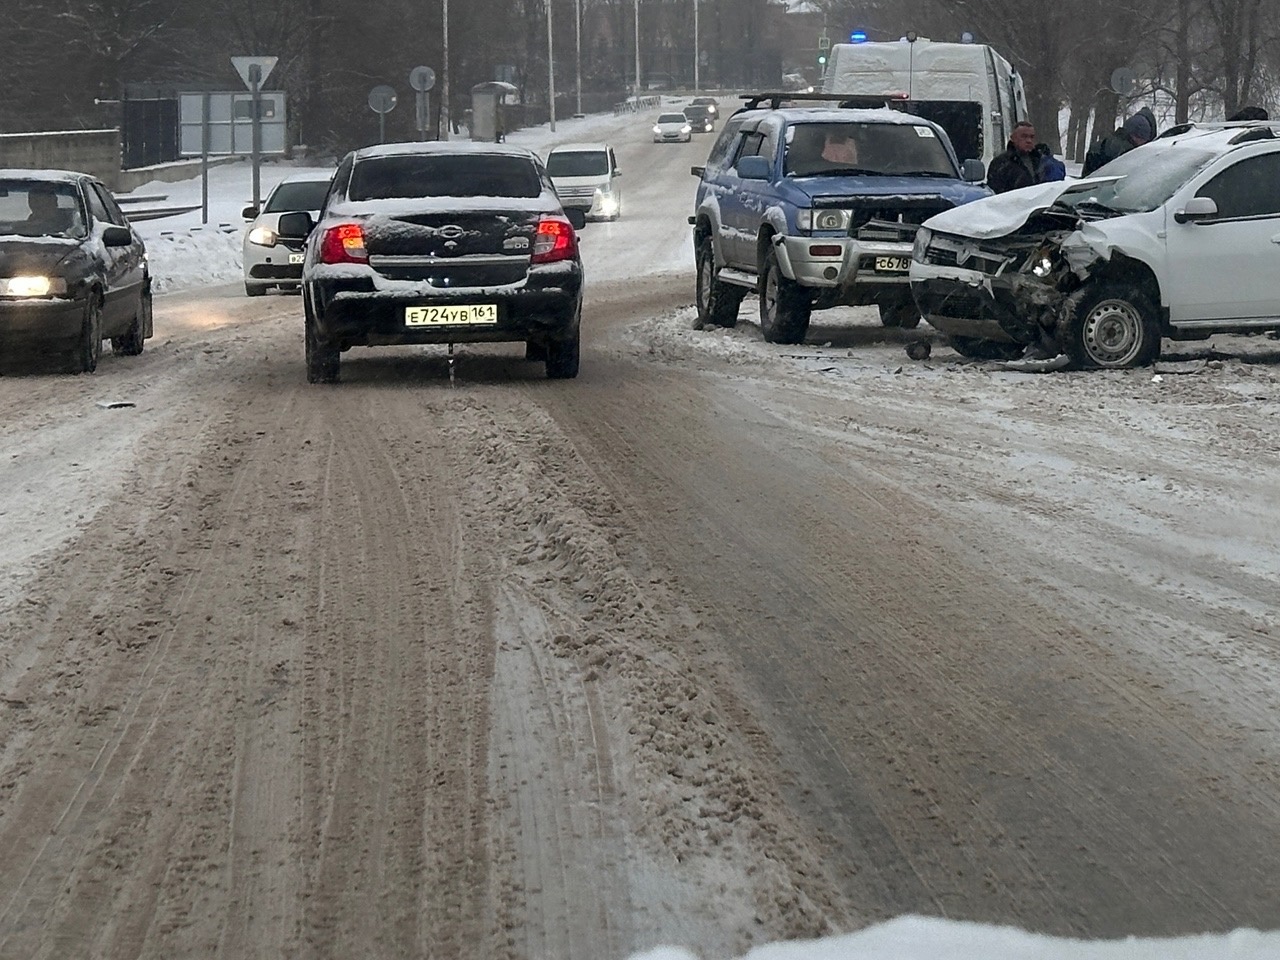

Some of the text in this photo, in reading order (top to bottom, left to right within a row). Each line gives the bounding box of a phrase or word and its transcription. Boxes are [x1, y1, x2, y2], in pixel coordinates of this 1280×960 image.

[880, 256, 912, 269] С678
[410, 306, 493, 323] Е724УВ 161
